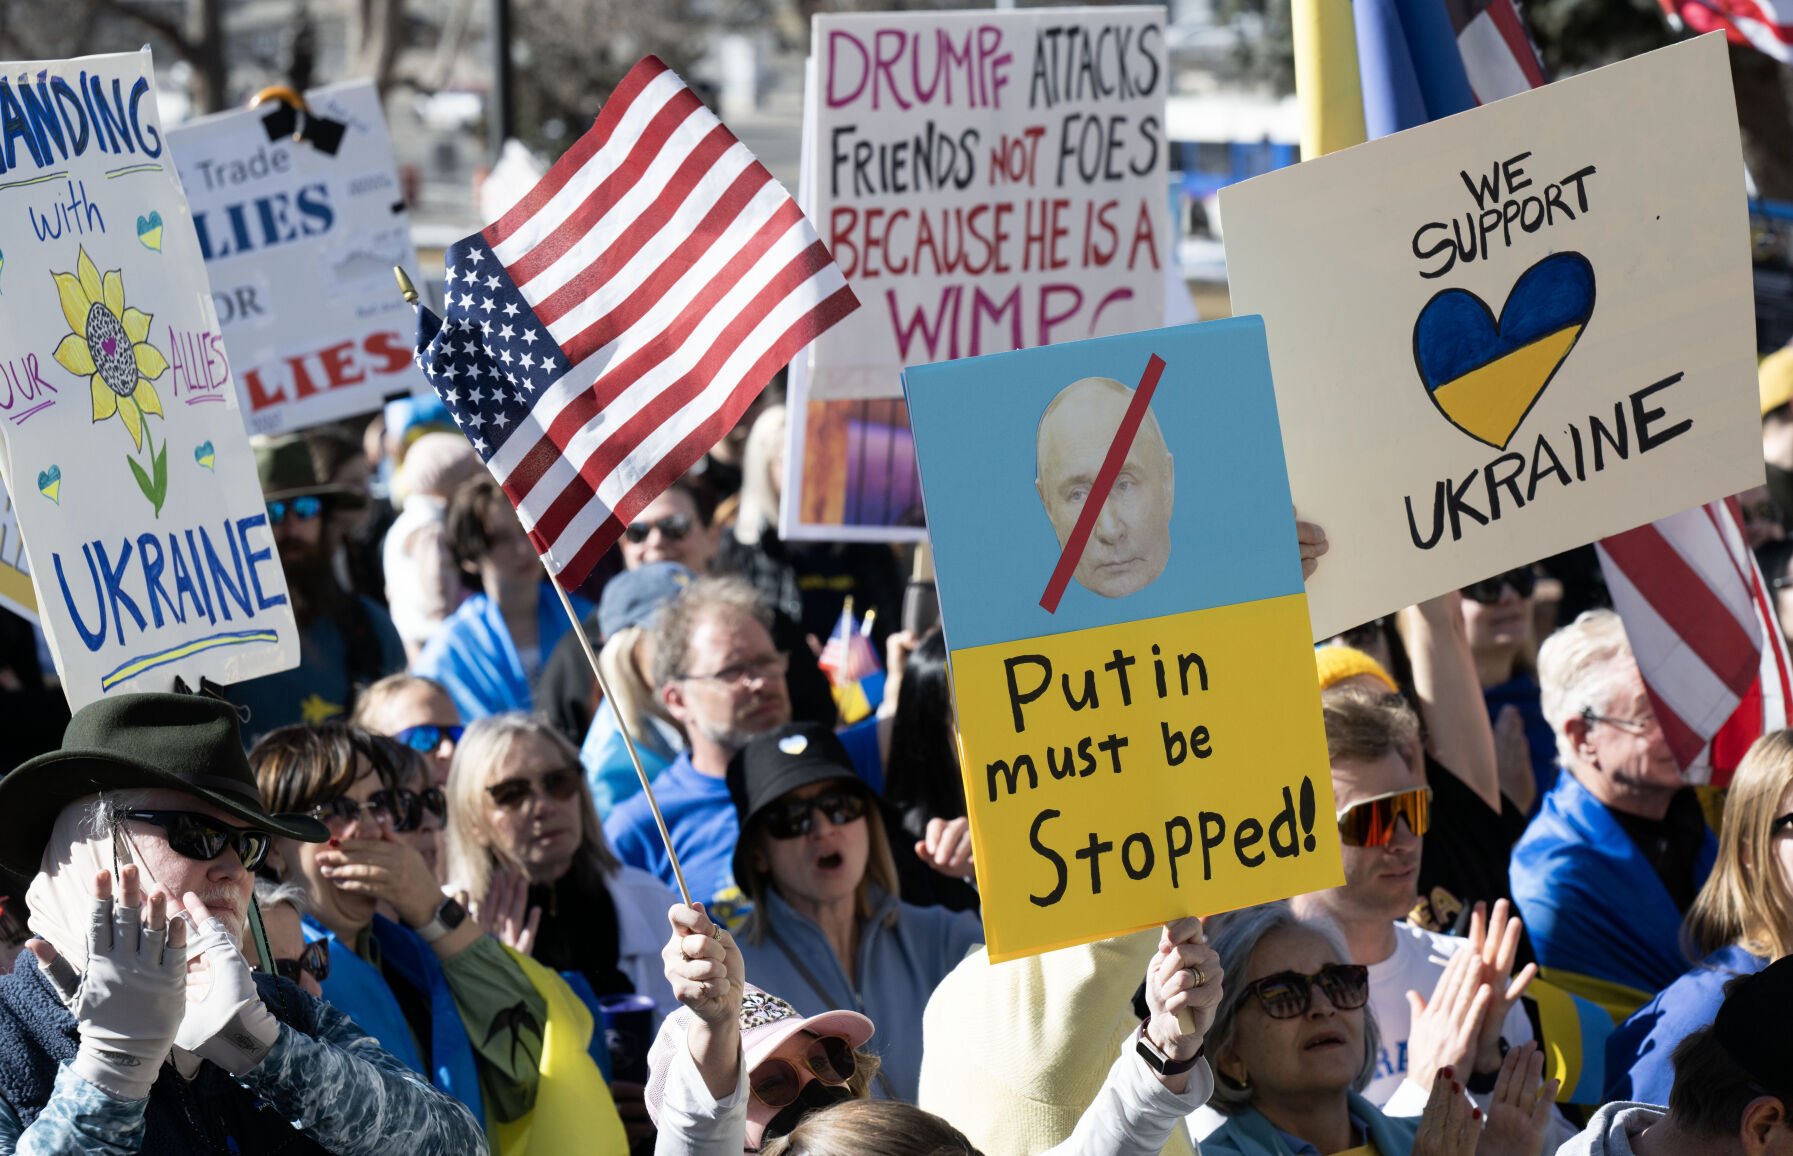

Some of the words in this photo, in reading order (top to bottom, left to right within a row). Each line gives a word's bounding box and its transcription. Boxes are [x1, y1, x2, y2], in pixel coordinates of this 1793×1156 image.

[826, 26, 1013, 111] DRUMPF
[1029, 24, 1160, 109] ATTACKS
[0, 69, 162, 174] ANDING
[831, 121, 979, 198] FRIENDS
[988, 126, 1046, 188] NOT
[1055, 113, 1160, 188] FOES
[196, 146, 290, 190] Trade
[1460, 151, 1532, 211] WE
[830, 202, 1014, 279] BECAUSE
[1023, 197, 1070, 272] HE
[1082, 199, 1119, 269] IS
[1128, 197, 1160, 271] A
[1412, 166, 1596, 279] SUPPORT
[168, 325, 229, 397] ALLIES
[243, 330, 414, 414] LIES
[1403, 371, 1694, 550] UKRAINE
[52, 513, 287, 653] UKRAINE
[1004, 643, 1209, 733] Putin
[986, 733, 1129, 802] must
[1160, 721, 1213, 767] be
[1028, 774, 1317, 908] Stopped!
